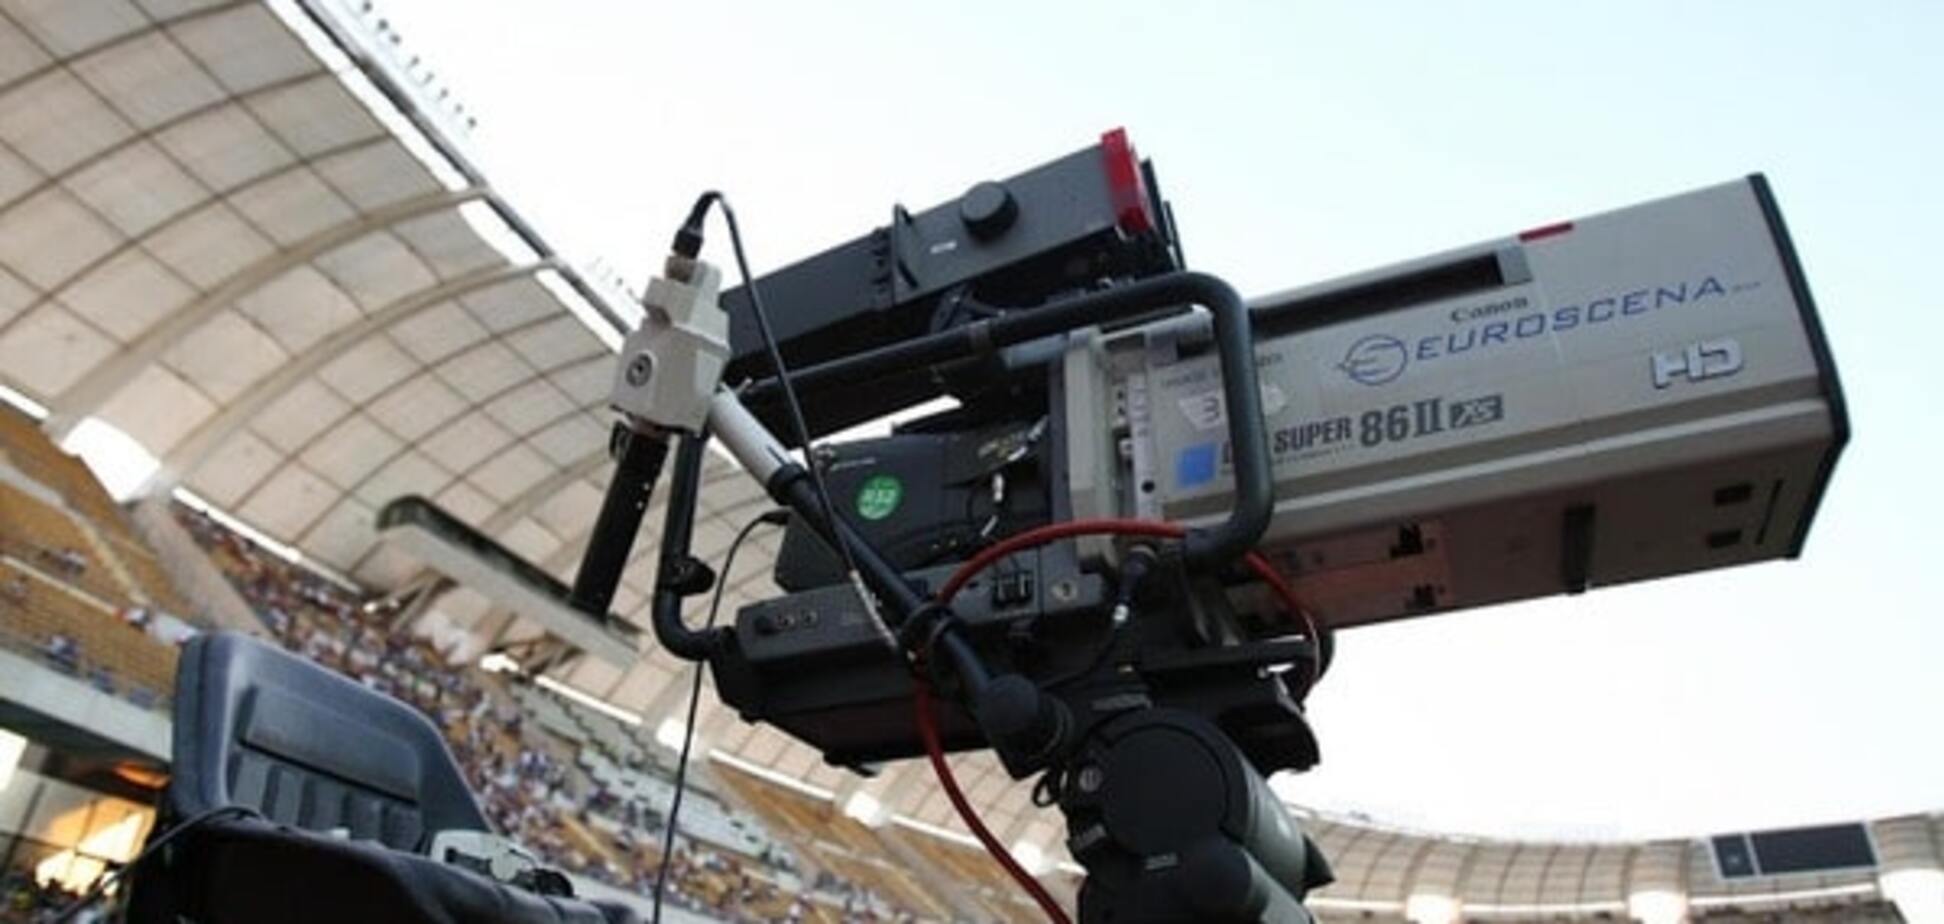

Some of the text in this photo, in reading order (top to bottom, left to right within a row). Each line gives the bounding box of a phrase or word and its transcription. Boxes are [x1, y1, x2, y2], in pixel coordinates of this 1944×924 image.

[1416, 276, 1725, 360] EUROSCENA
[1451, 297, 1528, 323] Canon
[1650, 338, 1744, 389] HD
[1273, 417, 1352, 453] SUPER
